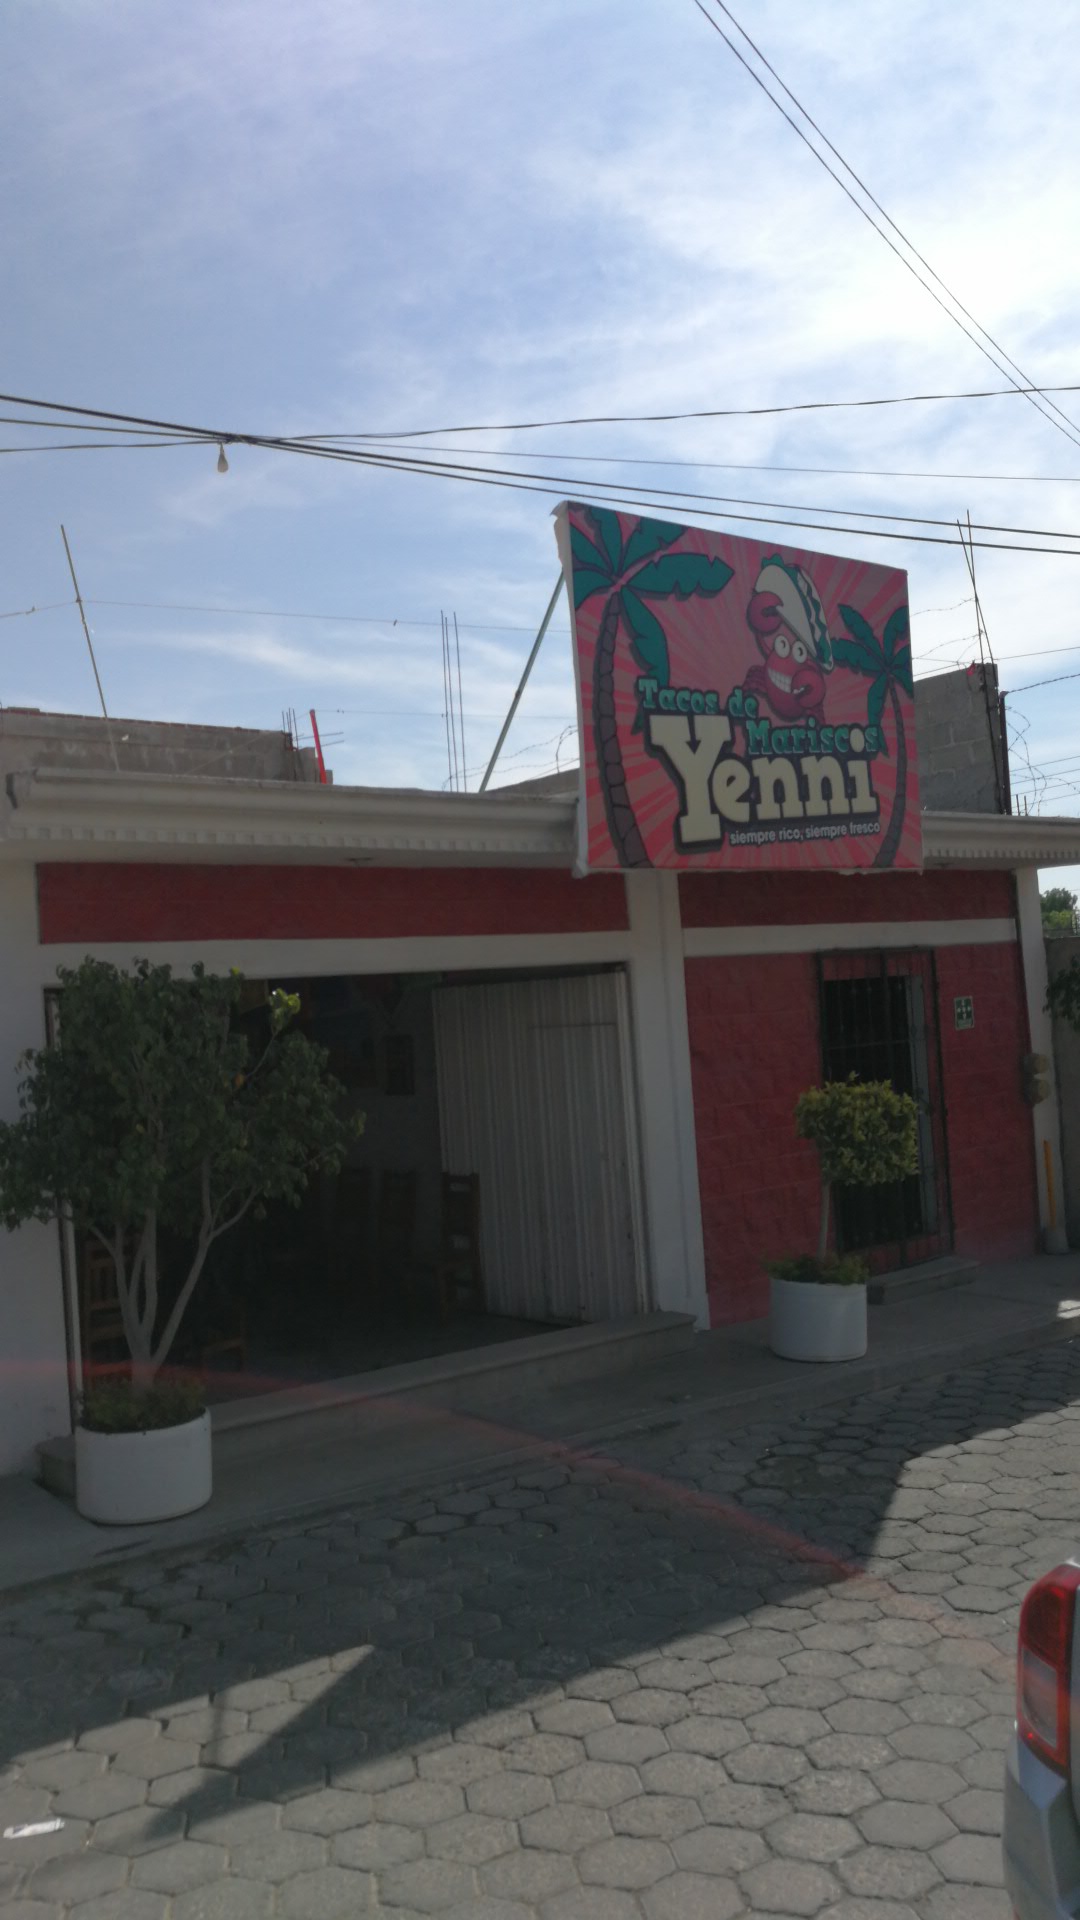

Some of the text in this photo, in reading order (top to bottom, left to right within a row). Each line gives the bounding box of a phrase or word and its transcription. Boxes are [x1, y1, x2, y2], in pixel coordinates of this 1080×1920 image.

[638, 678, 759, 718] Tacos de
[746, 717, 879, 755] Mariscos
[650, 714, 877, 843] Yenni
[730, 821, 881, 845] siempre rico, siempre fresco
